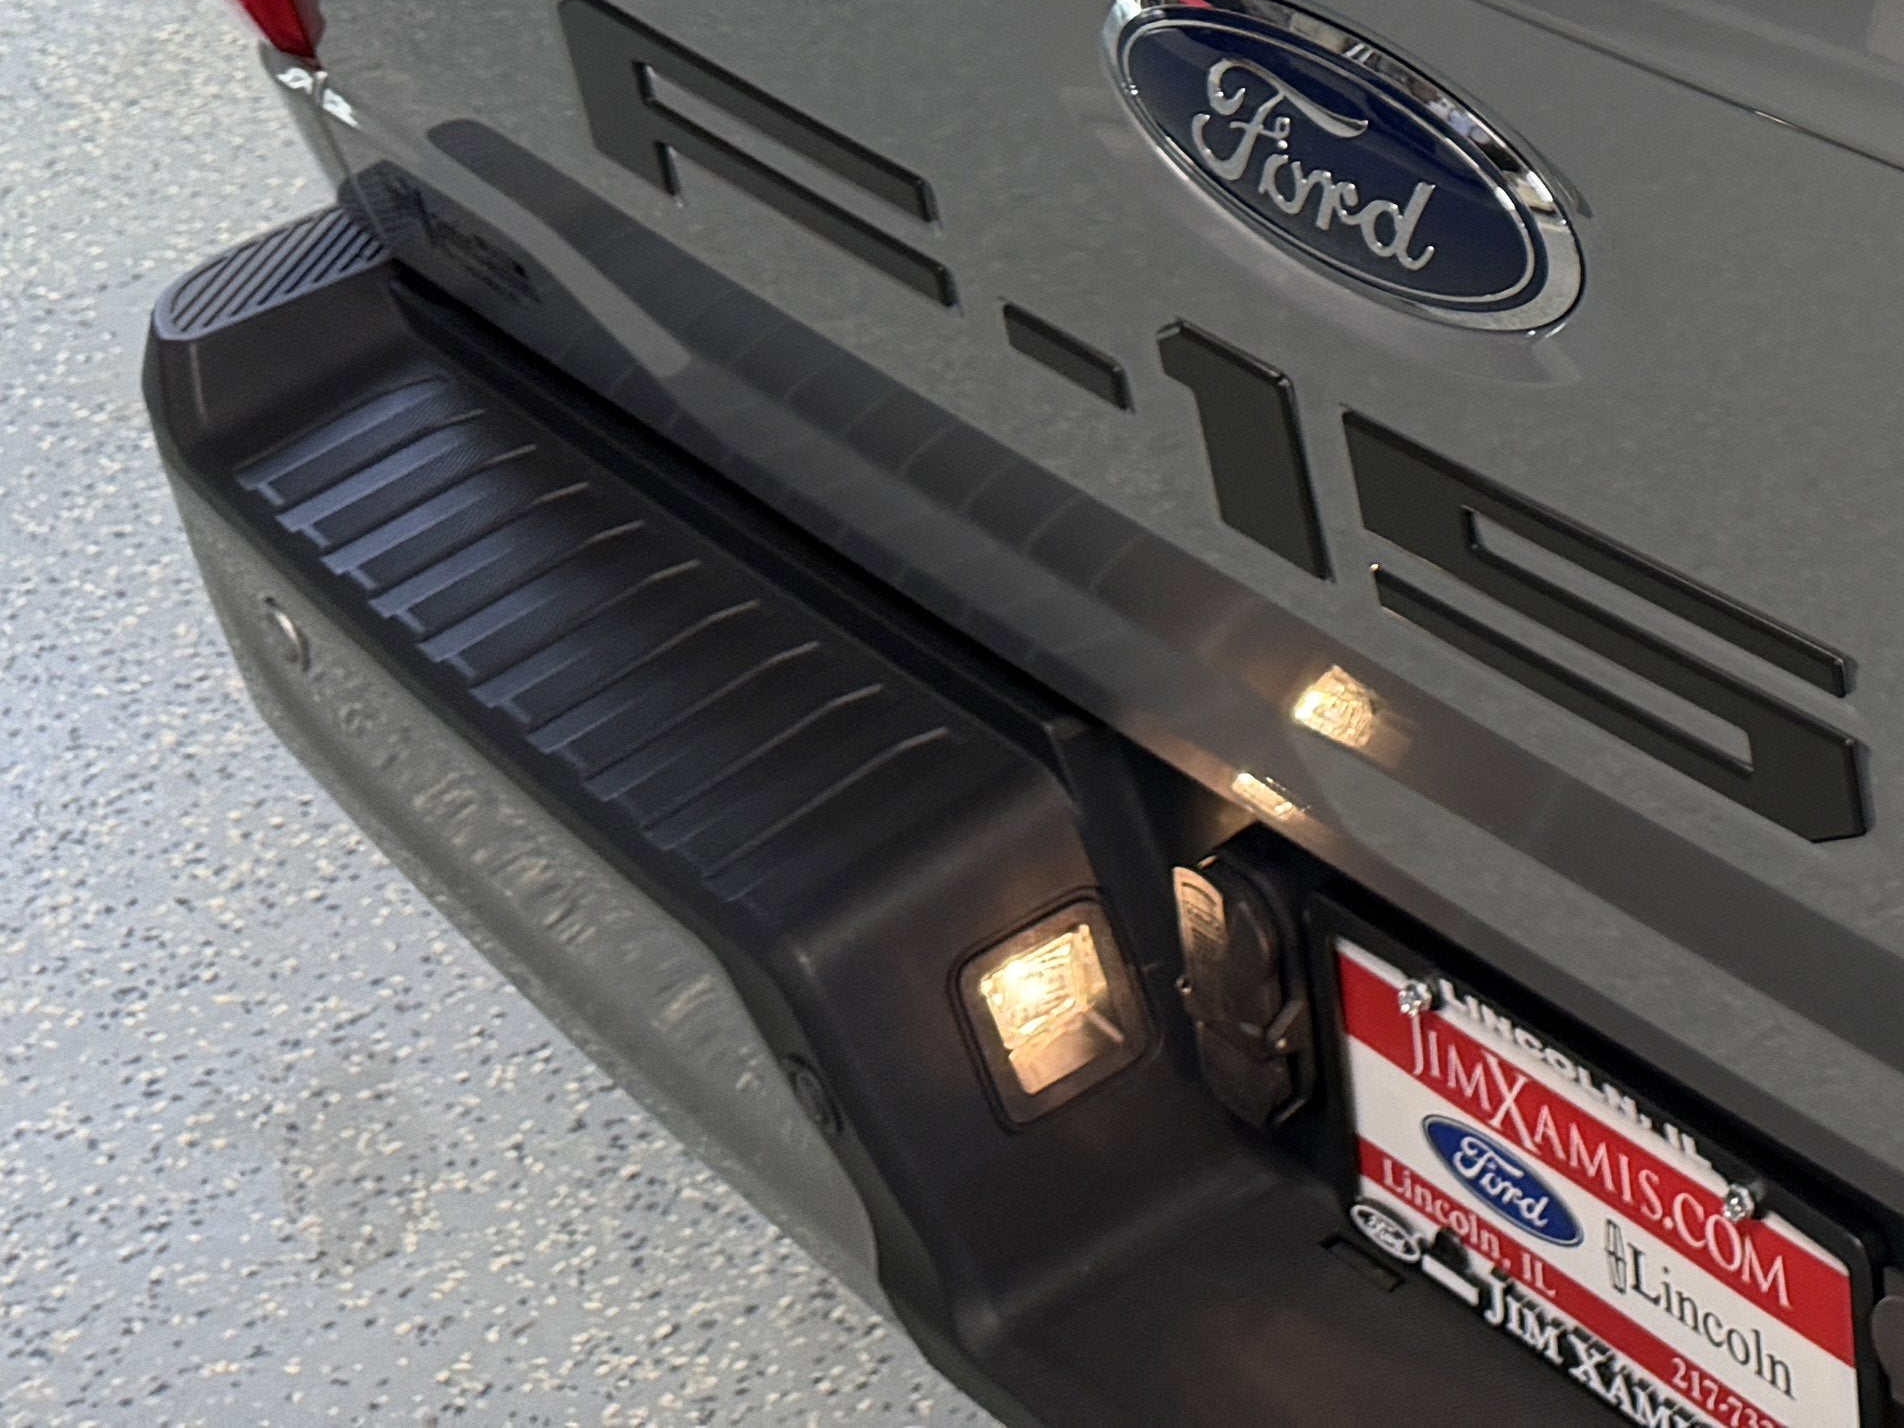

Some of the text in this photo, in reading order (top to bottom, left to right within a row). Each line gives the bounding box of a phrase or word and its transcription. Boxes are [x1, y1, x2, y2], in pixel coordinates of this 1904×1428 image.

[1191, 56, 1436, 271] Ford
[1382, 1157, 1556, 1299] Lincoln, IL
[1452, 1135, 1550, 1228] Ford
[1484, 1280, 1564, 1365] JIM
[1628, 1242, 1797, 1400] Lincoln
